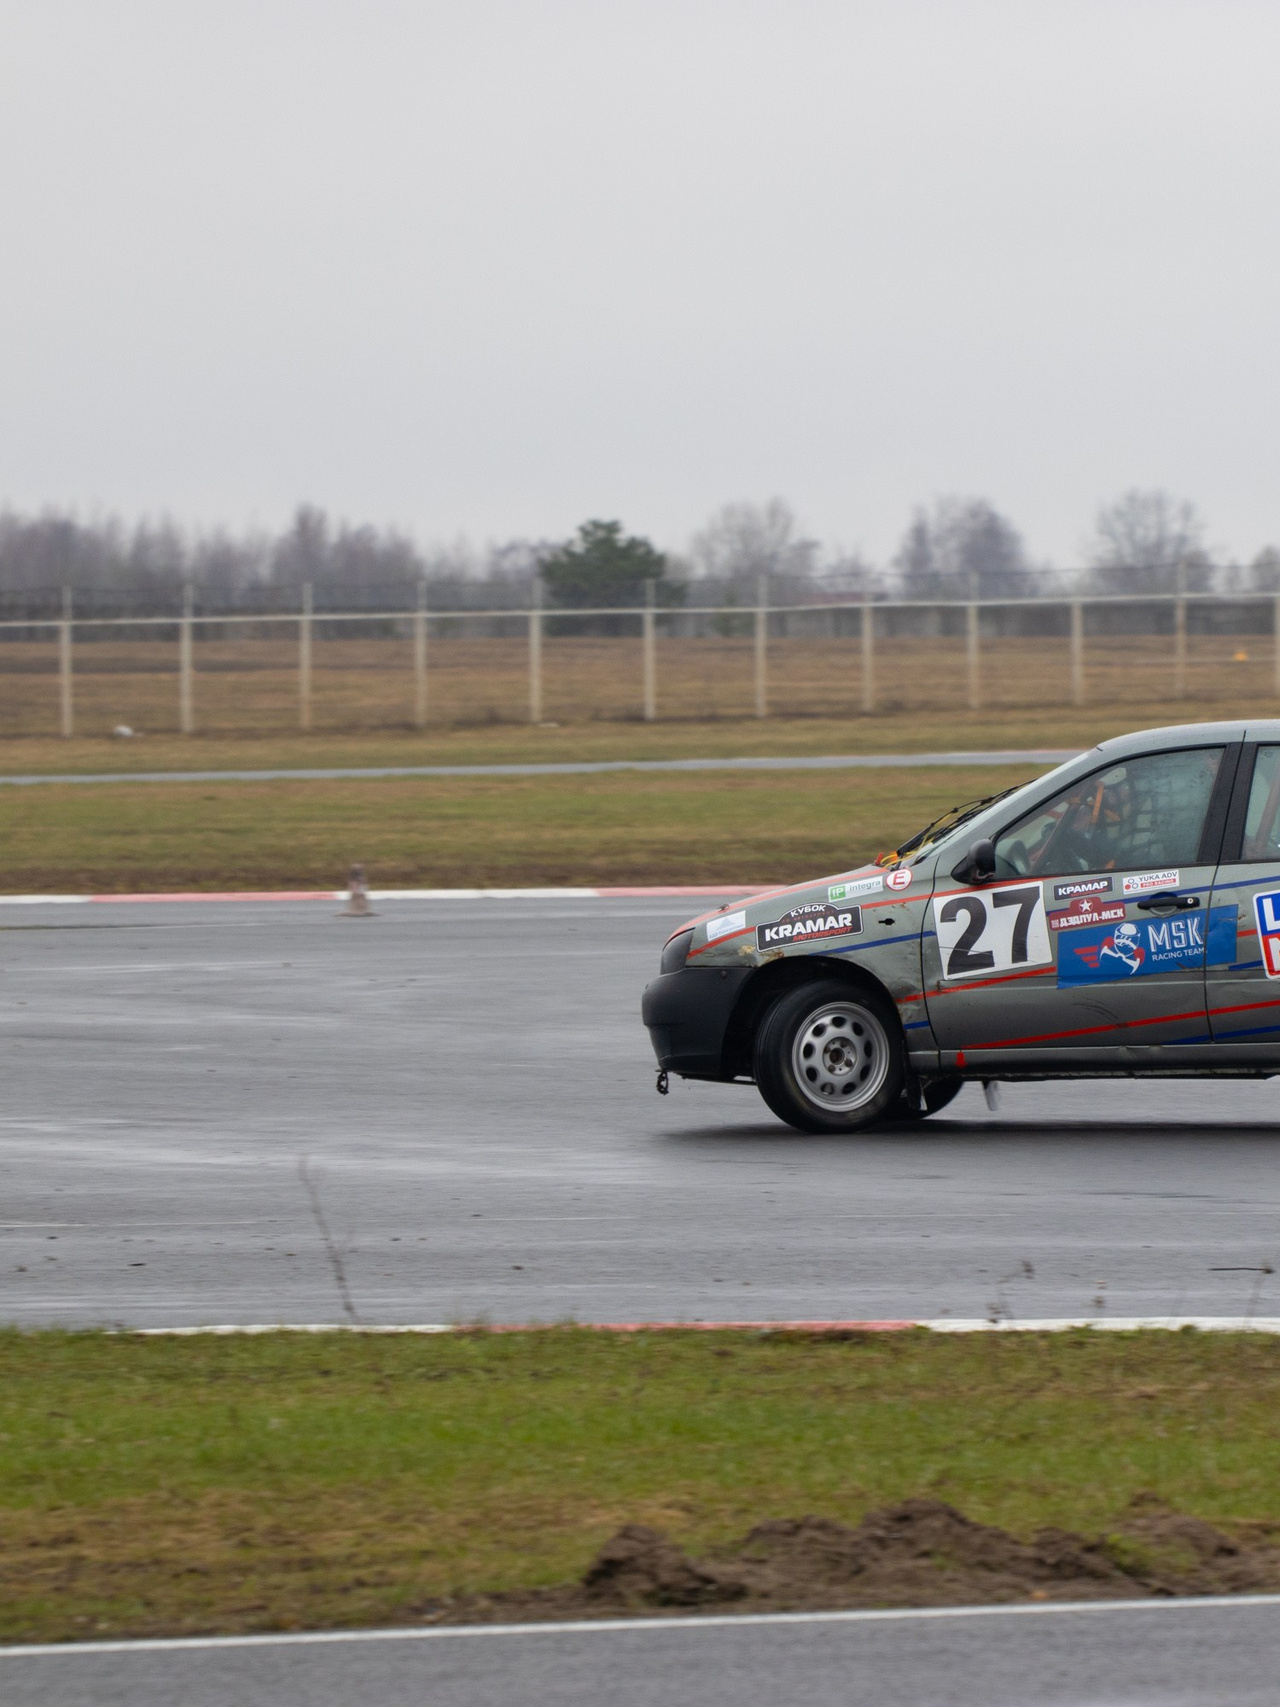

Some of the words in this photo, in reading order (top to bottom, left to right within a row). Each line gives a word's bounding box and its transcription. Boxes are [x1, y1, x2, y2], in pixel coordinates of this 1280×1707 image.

[892, 871, 906, 886] E
[1138, 874, 1161, 882] YUKA
[1161, 871, 1178, 879] ADV
[831, 887, 844, 898] IP
[849, 880, 881, 892] integra
[1058, 880, 1109, 896] КРАМАР
[790, 903, 827, 918] КУБОК
[764, 913, 853, 942] KRAMAR
[792, 926, 853, 942] MOTORSPORT
[940, 886, 1040, 976] 27
[1147, 916, 1204, 953] MSK
[1151, 950, 1183, 961] RACING
